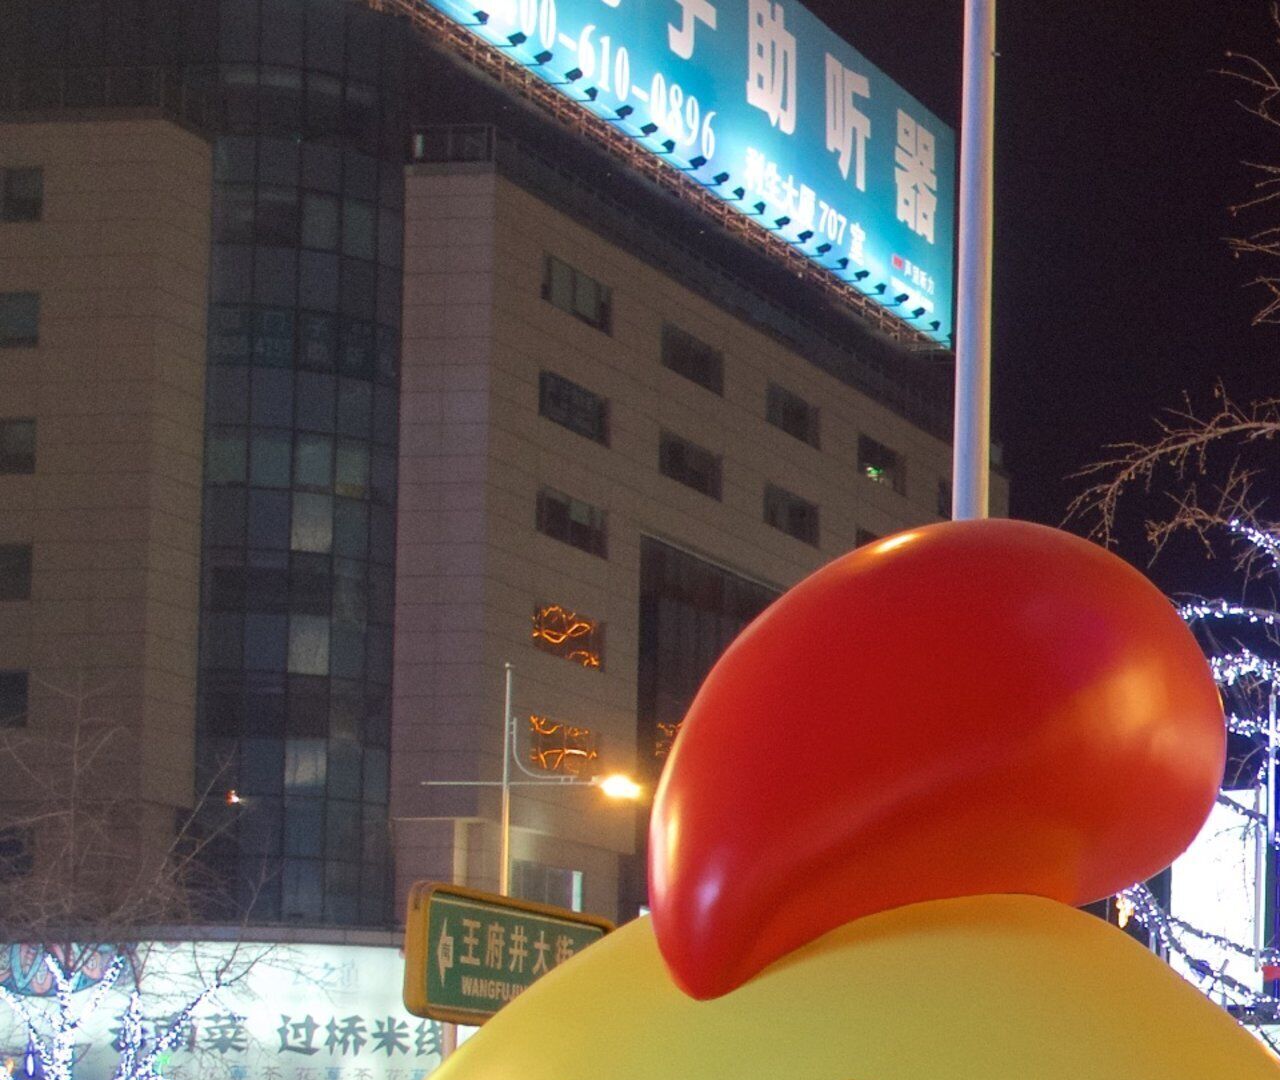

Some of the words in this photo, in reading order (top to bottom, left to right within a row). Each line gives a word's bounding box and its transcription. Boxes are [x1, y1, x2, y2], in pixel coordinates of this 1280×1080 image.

[819, 201, 847, 246] 707
[460, 918, 575, 975] 王府井大街
[277, 1014, 442, 1058] 过桥米线
